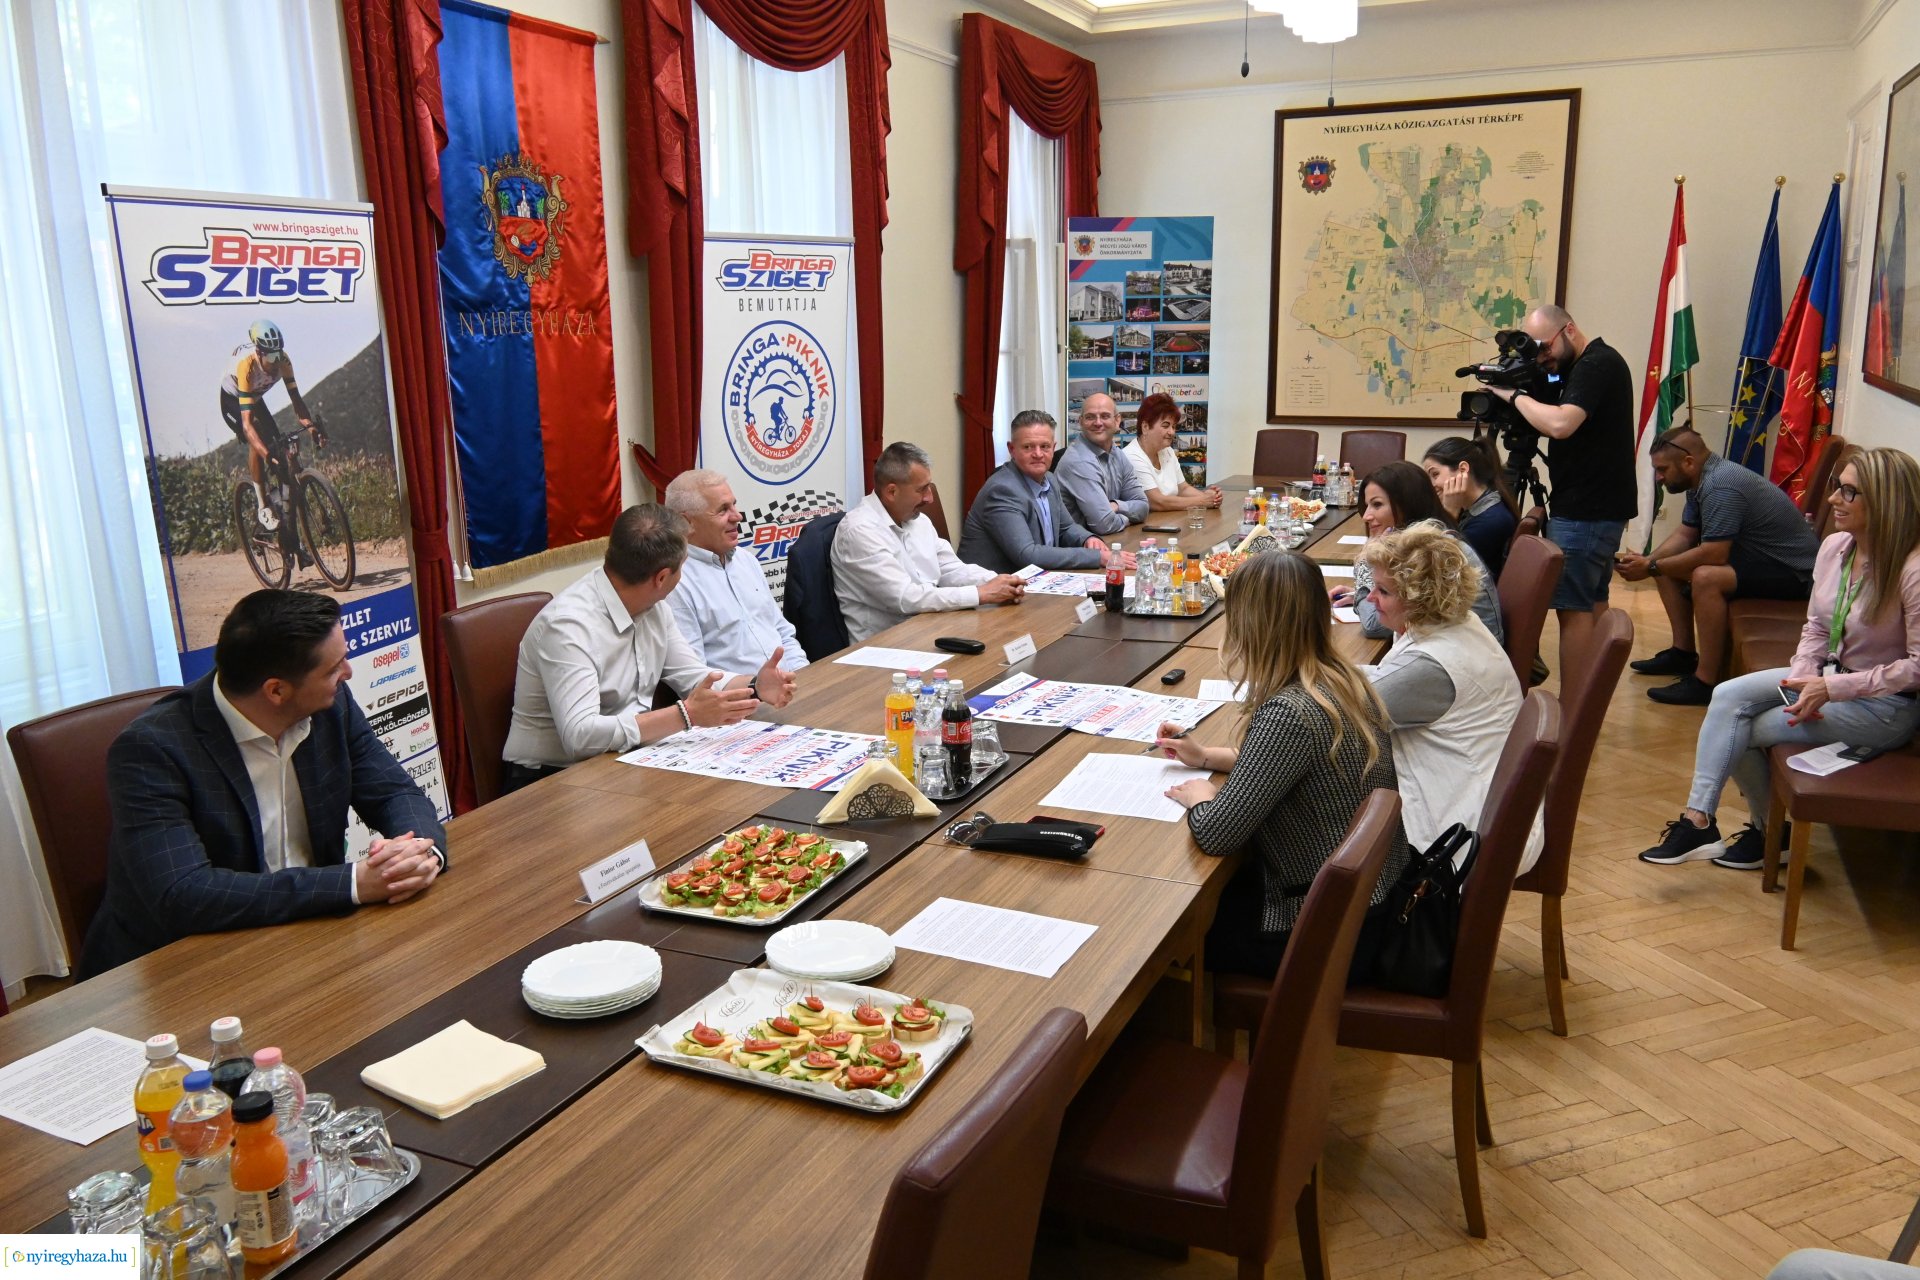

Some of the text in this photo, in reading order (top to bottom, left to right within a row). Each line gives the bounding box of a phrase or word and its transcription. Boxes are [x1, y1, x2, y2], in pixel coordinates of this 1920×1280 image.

[1324, 112, 1524, 134] NYÍREGYHÁZA KÖZIGAZGATÁSI TÉRKÉPE
[252, 221, 359, 237] www.bringasziget.hu
[211, 234, 361, 271] BRINGA
[750, 252, 834, 272] BRINGA
[156, 254, 359, 298] SZIGET
[722, 263, 831, 288] SZIGET
[738, 297, 817, 312] BEMUTATJA
[792, 429, 809, 451] TOKAJ
[340, 607, 372, 631] ZLET
[360, 616, 412, 647] SZERVIZ
[370, 665, 417, 689] LAPIERRE
[368, 711, 394, 727] ZERVIZ
